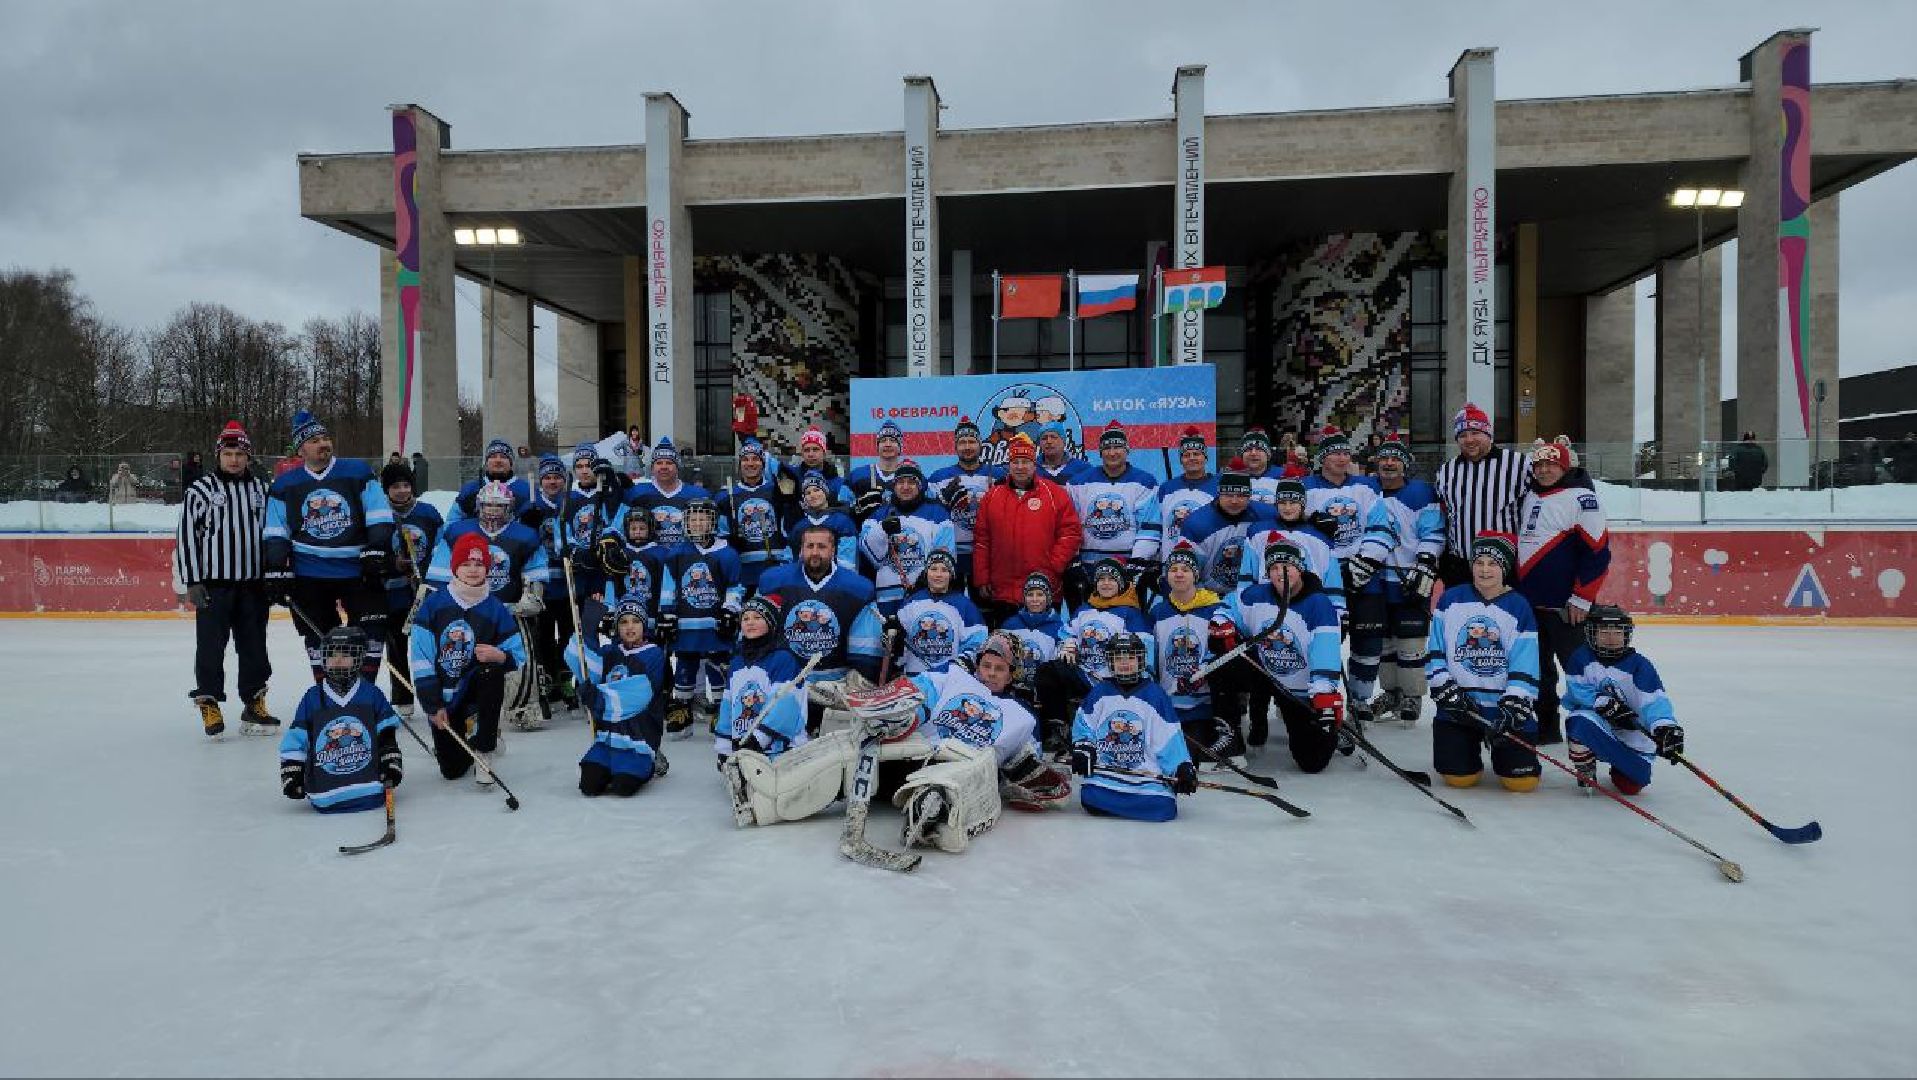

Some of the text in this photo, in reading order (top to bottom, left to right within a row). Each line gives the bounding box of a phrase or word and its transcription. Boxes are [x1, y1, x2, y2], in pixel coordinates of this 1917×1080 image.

[908, 145, 925, 252] ВПЕЧАТЛЕНИЙ
[1182, 136, 1199, 245] ВПЕЧАТЛЕНИЙ
[1472, 187, 1489, 284] УЛЬТРАЯРКО
[652, 219, 668, 308] УЛЬТРАЯРКО
[911, 256, 926, 309] ЯРКИХ
[654, 322, 668, 357] ЯУЗА
[912, 313, 926, 367] МЕСТО
[1183, 309, 1198, 363] МЕСТО
[1473, 299, 1488, 336] ЯУЗА
[654, 362, 670, 383] ДК
[1473, 341, 1490, 366] ДК
[888, 404, 959, 418] ФЕВРАЛЯ
[1092, 395, 1207, 412] КАТОК «ЯУЗА»
[55, 566, 90, 576] ПАРКИ
